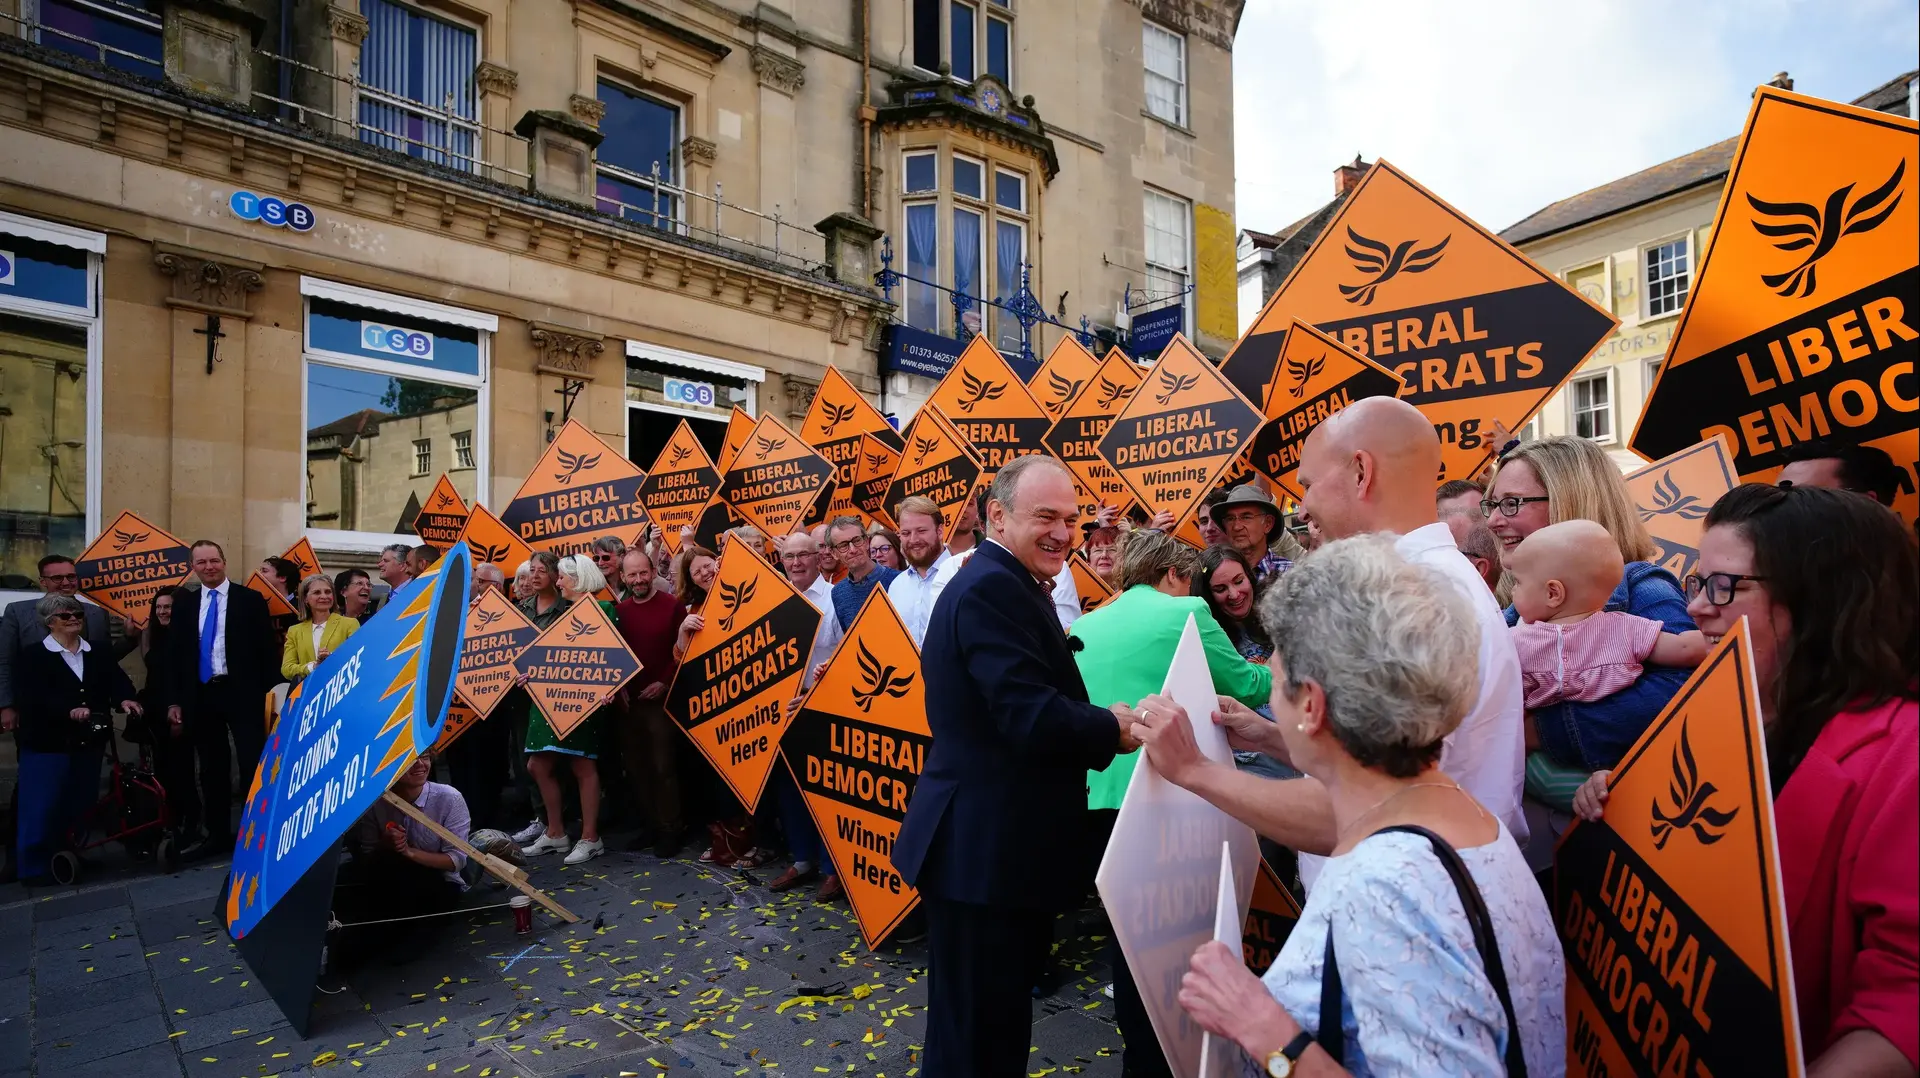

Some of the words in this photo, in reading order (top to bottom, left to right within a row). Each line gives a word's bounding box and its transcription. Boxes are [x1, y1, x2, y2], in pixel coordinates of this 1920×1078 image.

[239, 196, 308, 226] TSB
[1134, 316, 1178, 333] INDEPENDENT
[1139, 327, 1173, 341] OPTICIANS
[371, 329, 426, 351] TSB
[1736, 296, 1919, 396] LIBER
[909, 345, 932, 358] 01373
[932, 351, 959, 365] 462573
[1393, 341, 1544, 396] CRATS
[670, 384, 710, 402] TSB
[1135, 408, 1216, 440] LIBERAL
[1279, 387, 1355, 441] LIBERAL
[957, 423, 1020, 443] BERAL
[1116, 428, 1239, 465] DEMOCRATS
[658, 471, 700, 490] LIBERAL
[743, 461, 803, 484] LIBERAL
[904, 465, 953, 496] LIBERAL
[1142, 466, 1207, 487] Winning
[647, 485, 710, 506] DEMOCRATS
[730, 473, 820, 503] DEMOCRATS
[1101, 481, 1126, 493] Her
[1155, 487, 1192, 503] Here
[538, 485, 620, 515] LIBERAL
[753, 499, 802, 515] Winning
[430, 516, 462, 528] LIBERAL
[520, 502, 643, 539] DEMOCRATS
[660, 508, 694, 522] Winning
[765, 514, 792, 526] Here
[549, 539, 595, 558] Winn
[97, 551, 169, 573] LIBERAL
[80, 561, 188, 590] DEMOCRATS
[109, 585, 164, 600] Winnin
[545, 649, 608, 665] LIBERAL
[704, 620, 776, 681] LIBERAL
[463, 670, 510, 686] Winning
[528, 665, 622, 682] DEMOCRATS
[688, 637, 799, 721] DEMOCRATS
[298, 690, 324, 743] GET
[322, 645, 365, 718] THESE
[472, 684, 500, 696] Here
[545, 687, 596, 702] Winning
[553, 702, 582, 713] Here
[715, 700, 781, 745] Winning
[287, 718, 342, 800] CLOWNS
[731, 736, 768, 766] Here
[807, 754, 911, 813] DEMOCR
[276, 805, 304, 861] OUT
[301, 789, 322, 840] OF
[320, 778, 340, 824] No
[836, 814, 895, 858] Winni
[853, 852, 901, 895] Here
[1600, 850, 1717, 1033] LIBERAL
[1564, 890, 1713, 1078] DEMOCRA
